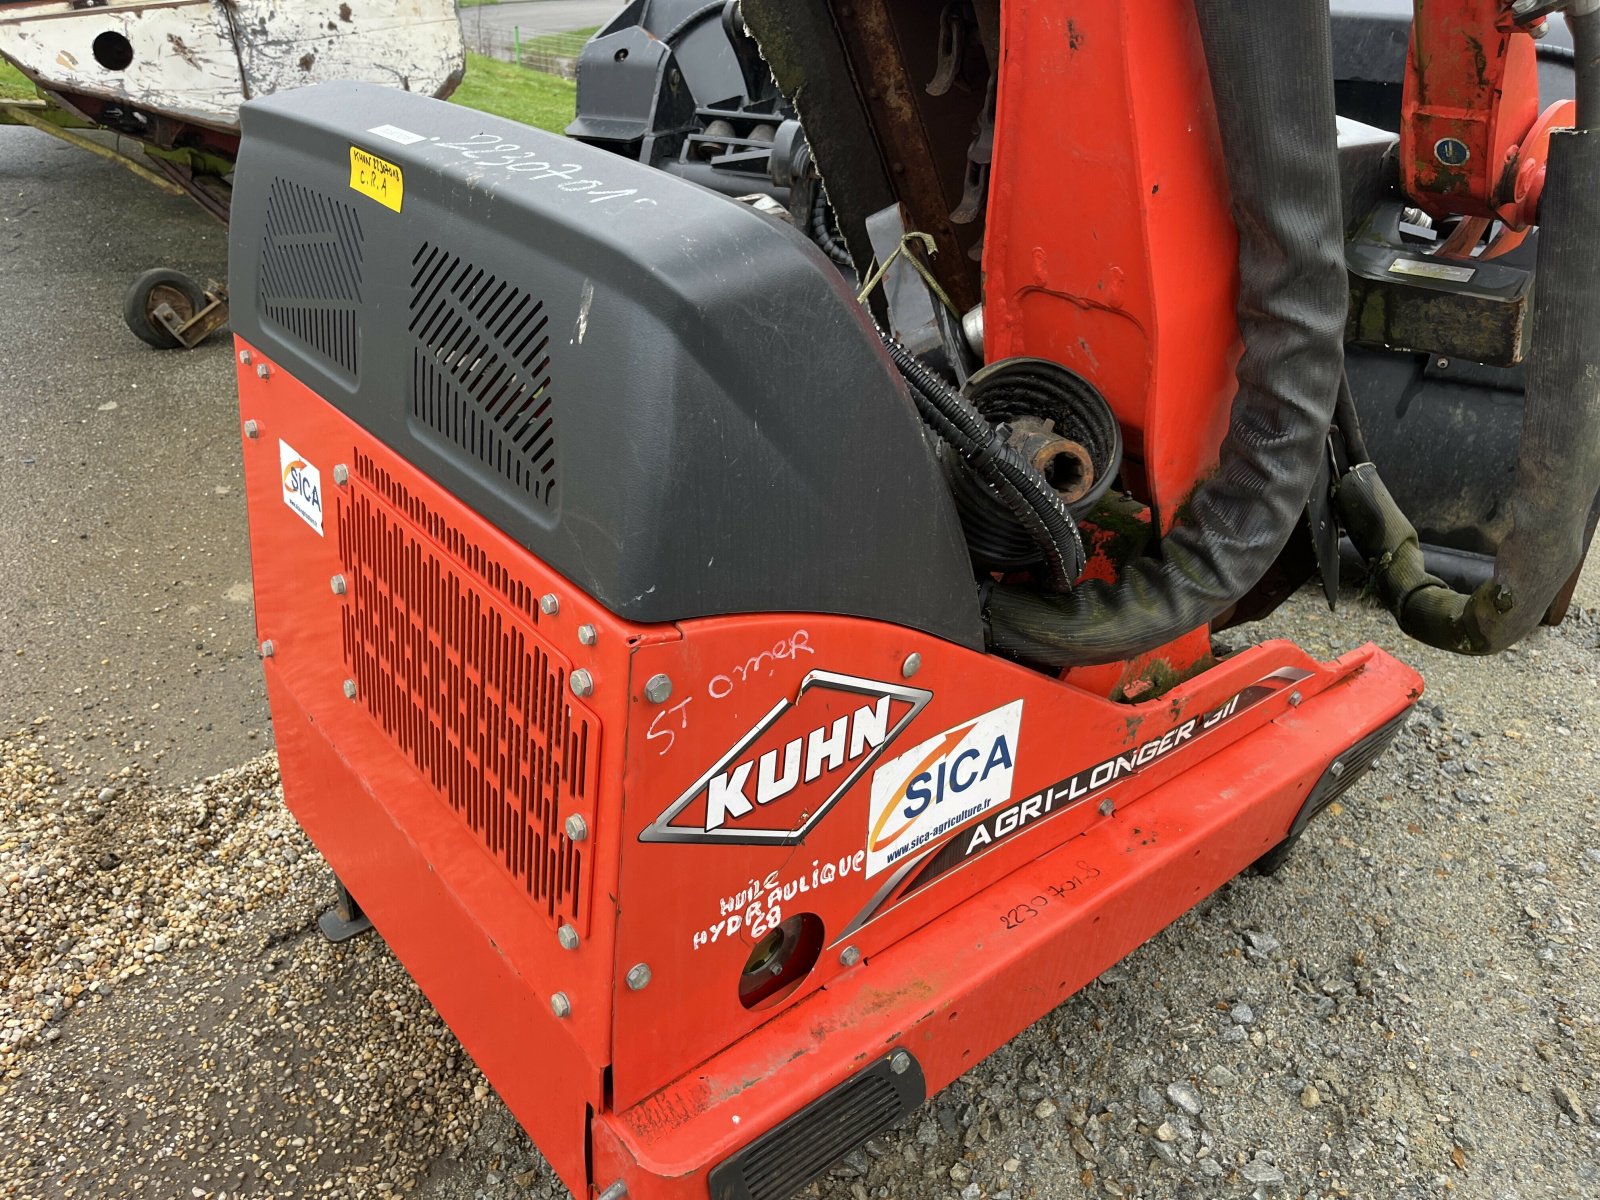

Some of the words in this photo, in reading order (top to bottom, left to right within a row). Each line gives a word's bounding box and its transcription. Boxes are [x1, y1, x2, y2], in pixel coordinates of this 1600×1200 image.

[290, 466, 322, 513] SICA
[646, 696, 693, 756] ST
[704, 694, 891, 833] KUHN
[903, 734, 1013, 820] SICA
[964, 718, 1197, 856] AGRI-LONGER
[886, 797, 992, 864] www.sica-agriculture.fr
[750, 904, 783, 939] 68
